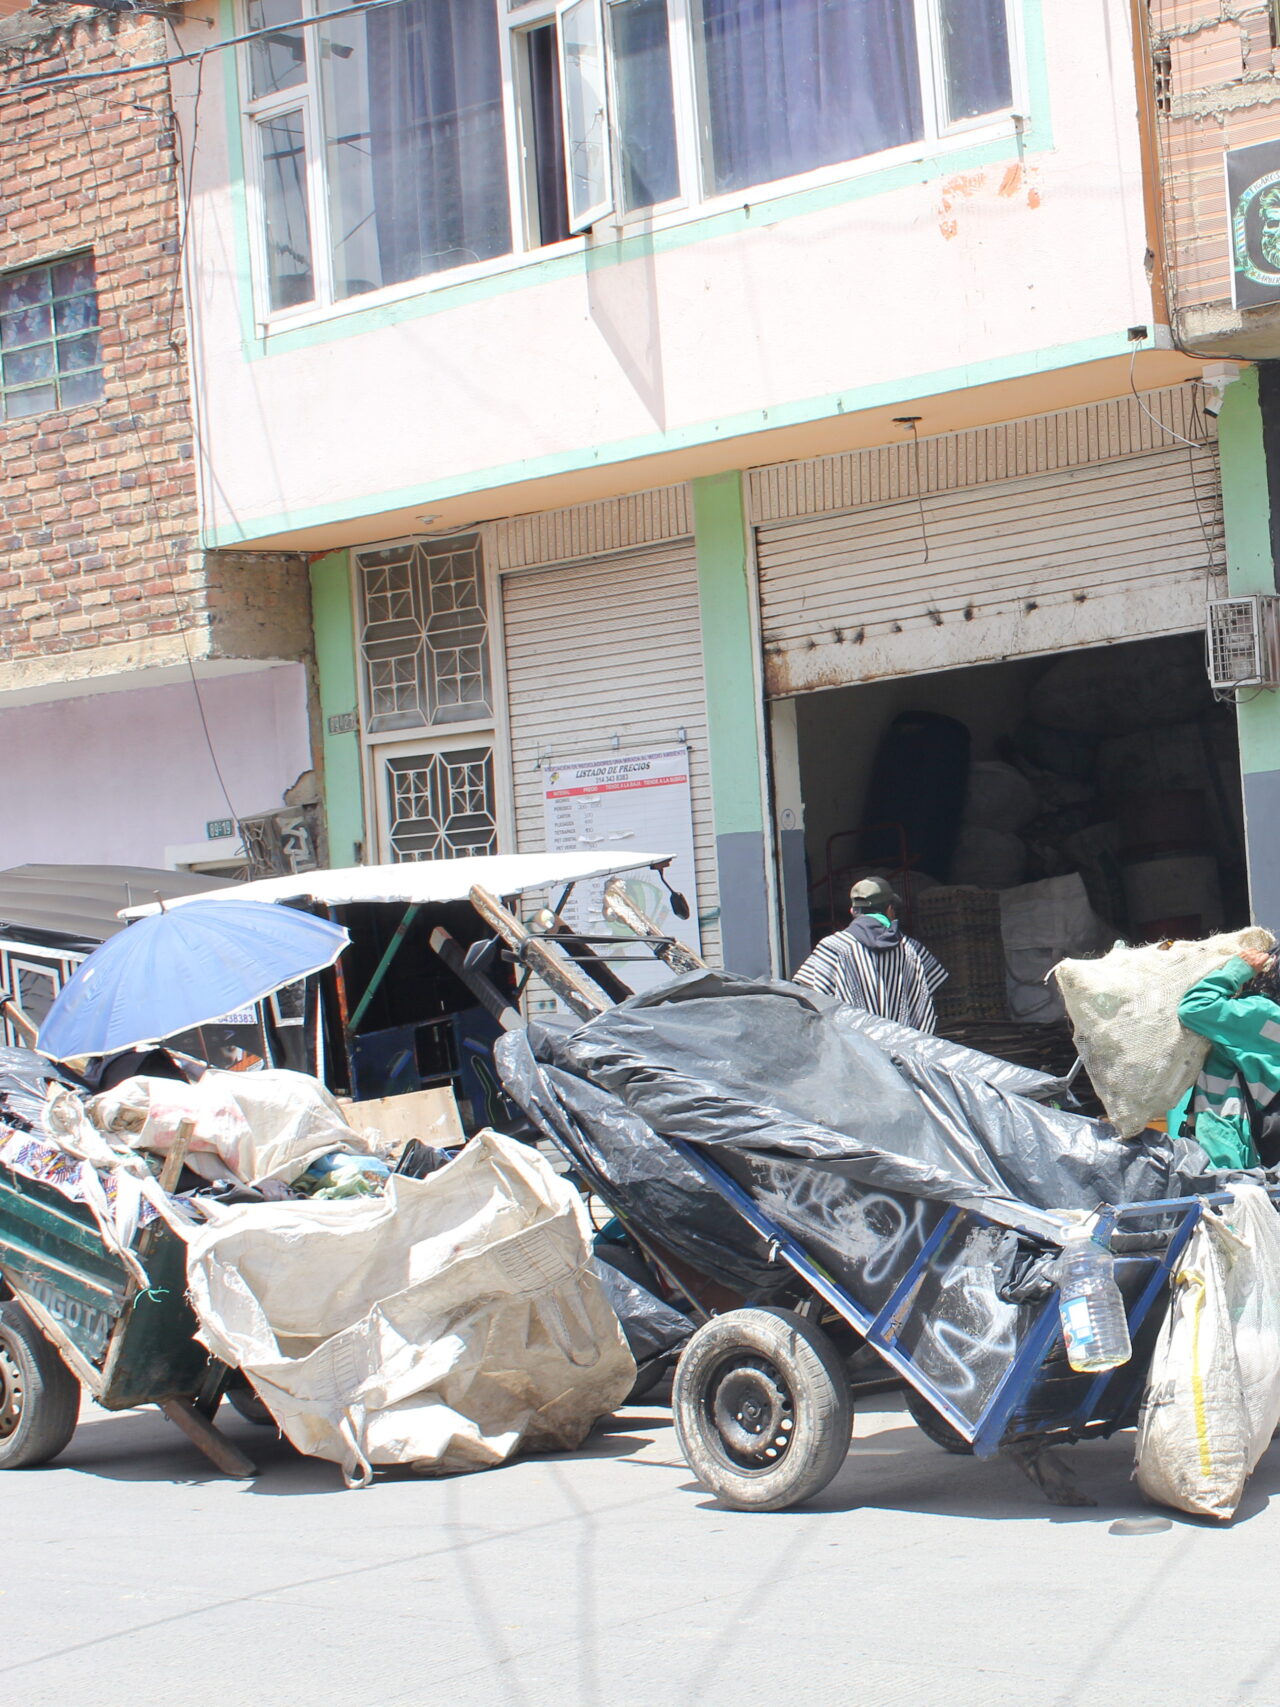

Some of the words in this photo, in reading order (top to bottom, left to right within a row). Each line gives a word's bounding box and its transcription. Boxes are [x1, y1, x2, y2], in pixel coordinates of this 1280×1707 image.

[576, 767, 607, 779] LISTADO
[607, 765, 619, 775] DE
[618, 761, 651, 774] PRECIOS
